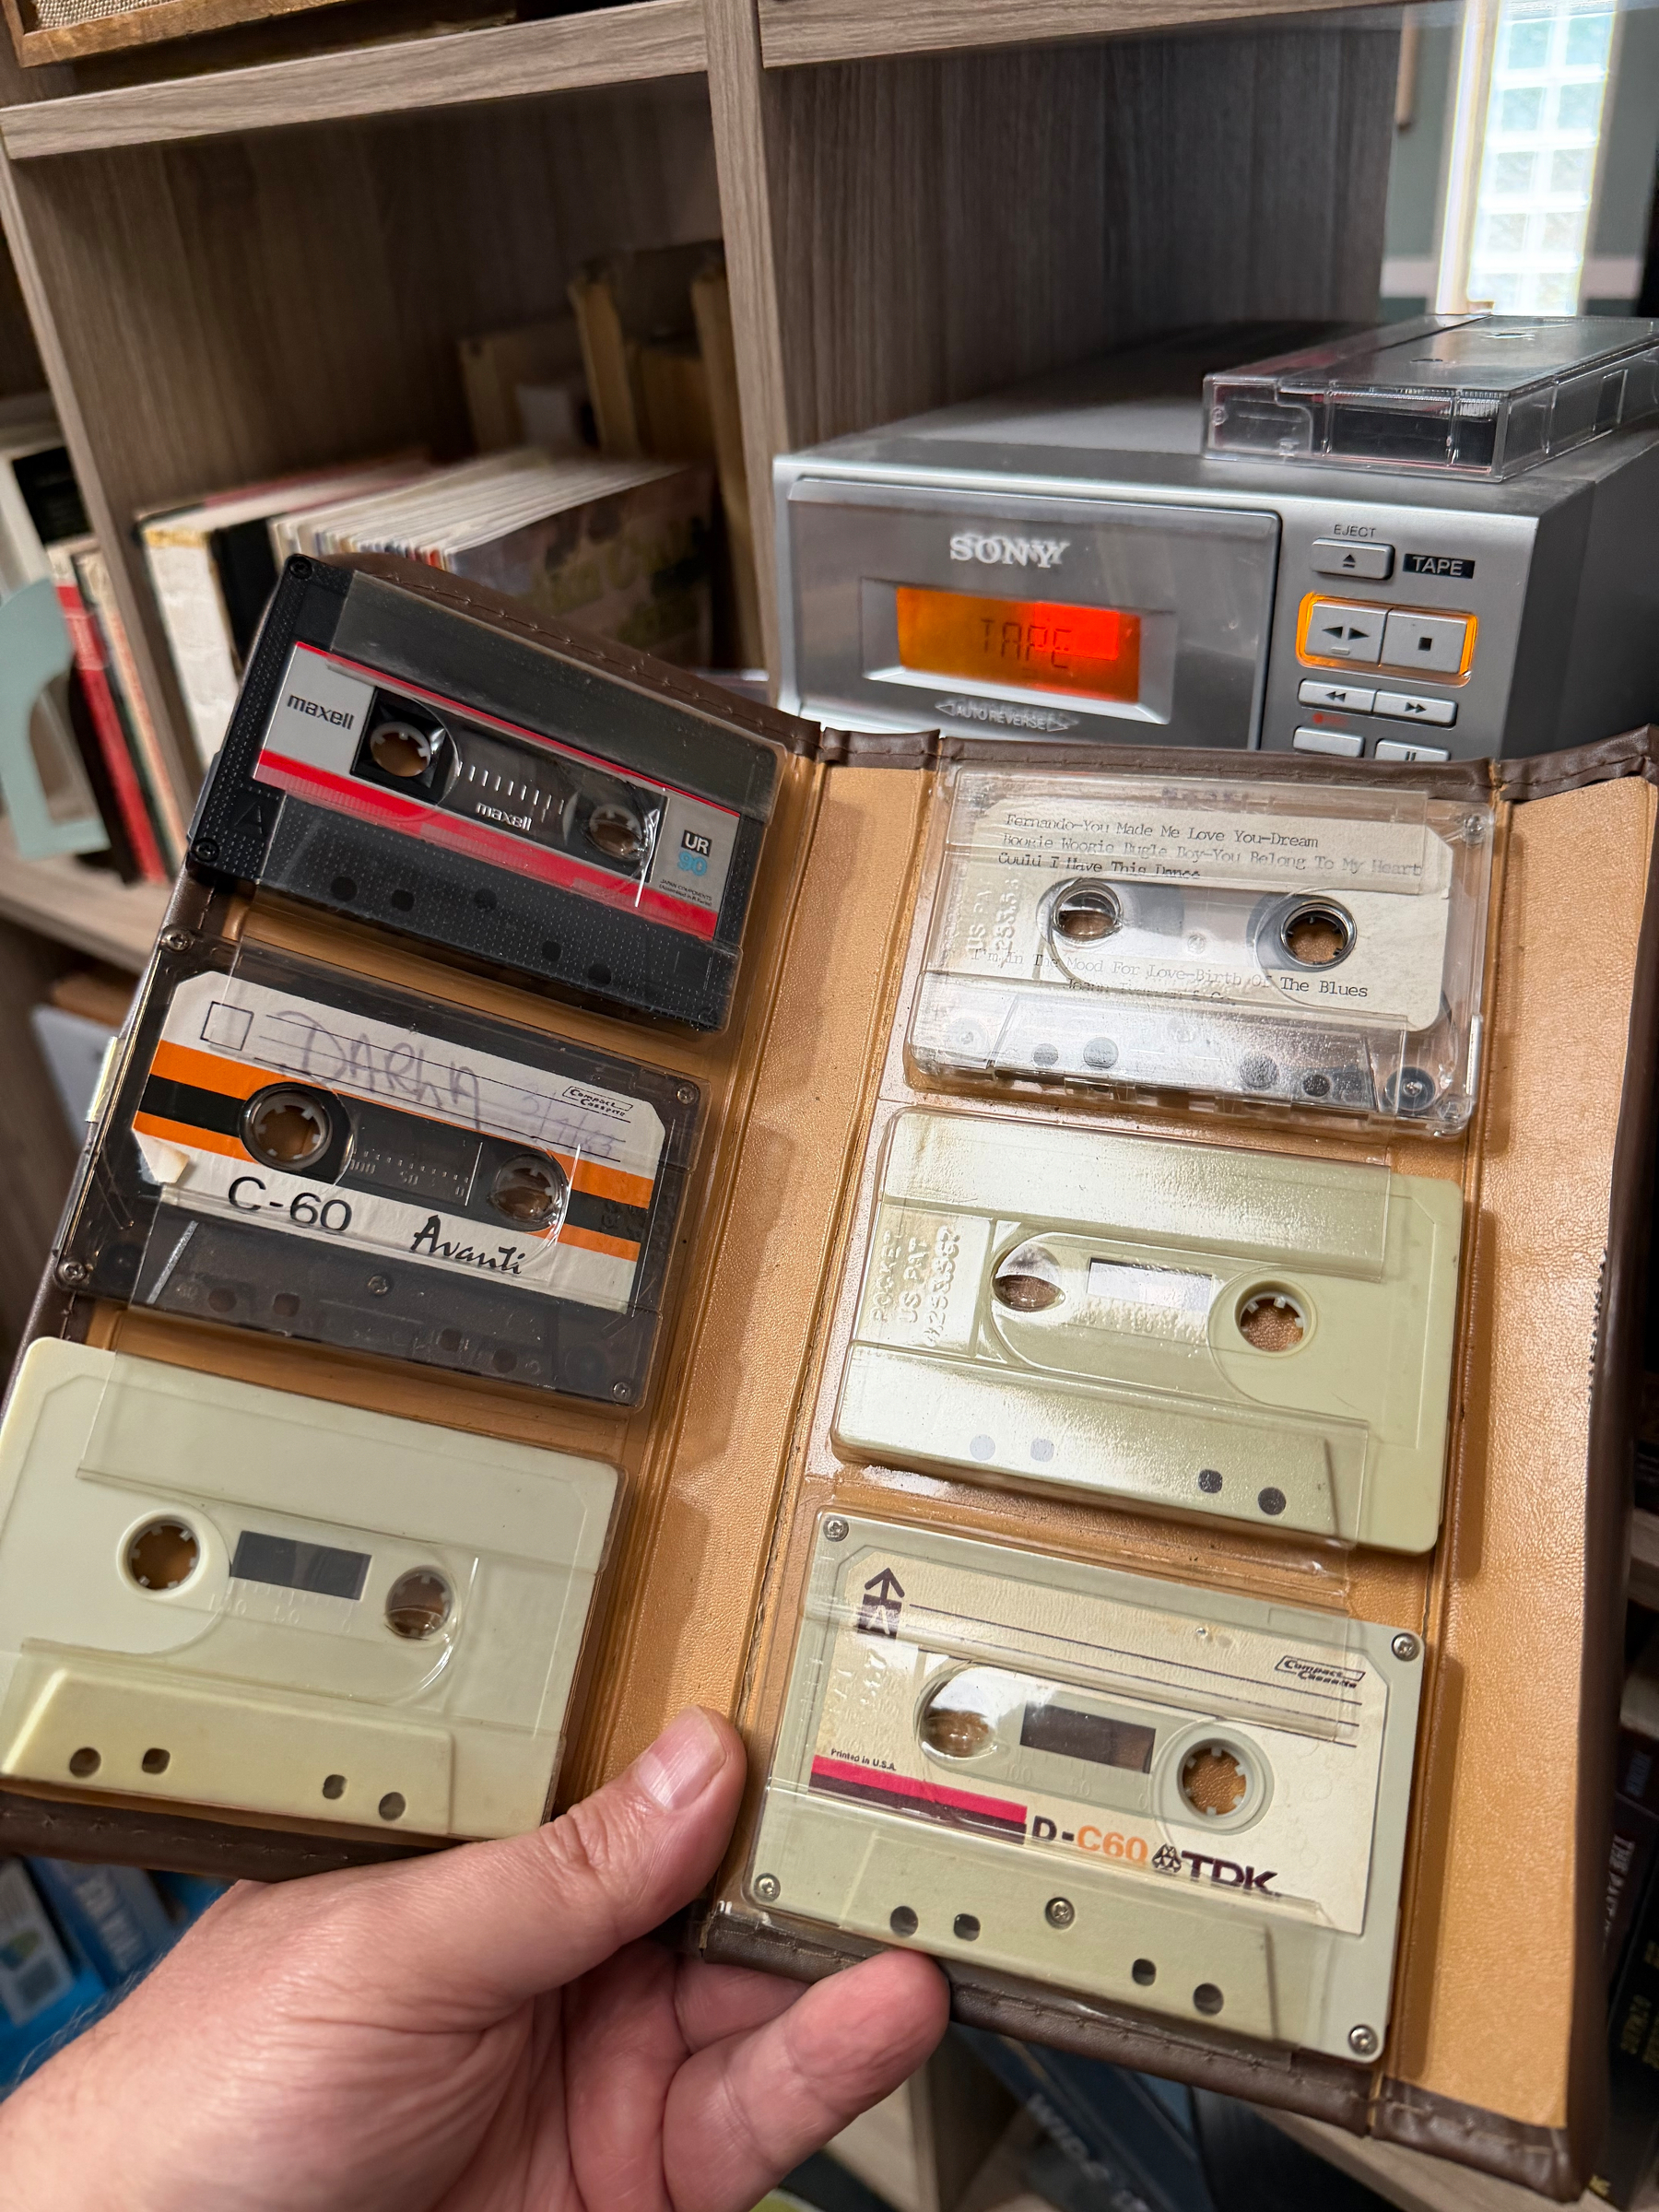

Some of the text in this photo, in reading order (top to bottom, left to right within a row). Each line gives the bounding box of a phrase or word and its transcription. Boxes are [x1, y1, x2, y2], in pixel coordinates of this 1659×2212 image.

[1333, 524, 1377, 538] EJECT
[949, 533, 1070, 569] SONY
[1412, 556, 1465, 577] TAPE
[980, 618, 1072, 669] TAPE
[287, 694, 356, 731] maxell
[956, 700, 1049, 731] AUTO REVERSE
[475, 801, 533, 832] maxell
[1005, 813, 1319, 848] Fernando-You Made Me Love You-Dream
[685, 832, 710, 855] UR
[1003, 832, 1422, 877] Boogie Woogie Bugle Boy-You Belong To My Heart
[677, 850, 708, 877] 90
[1050, 856, 1060, 868] I
[1066, 856, 1103, 873] Have
[1111, 861, 1147, 874] This
[971, 948, 1369, 998] I'm In The Mood For Love-Birth Of The Blues
[569, 1088, 616, 1108] Compact
[228, 1175, 353, 1232] C-60
[412, 1213, 526, 1276] Avanti
[865, 1604, 891, 1635] A
[1283, 1659, 1344, 1678] Compact
[830, 1747, 861, 1762] Printed
[861, 1755, 871, 1764] in
[1030, 1814, 1149, 1866] D-C60
